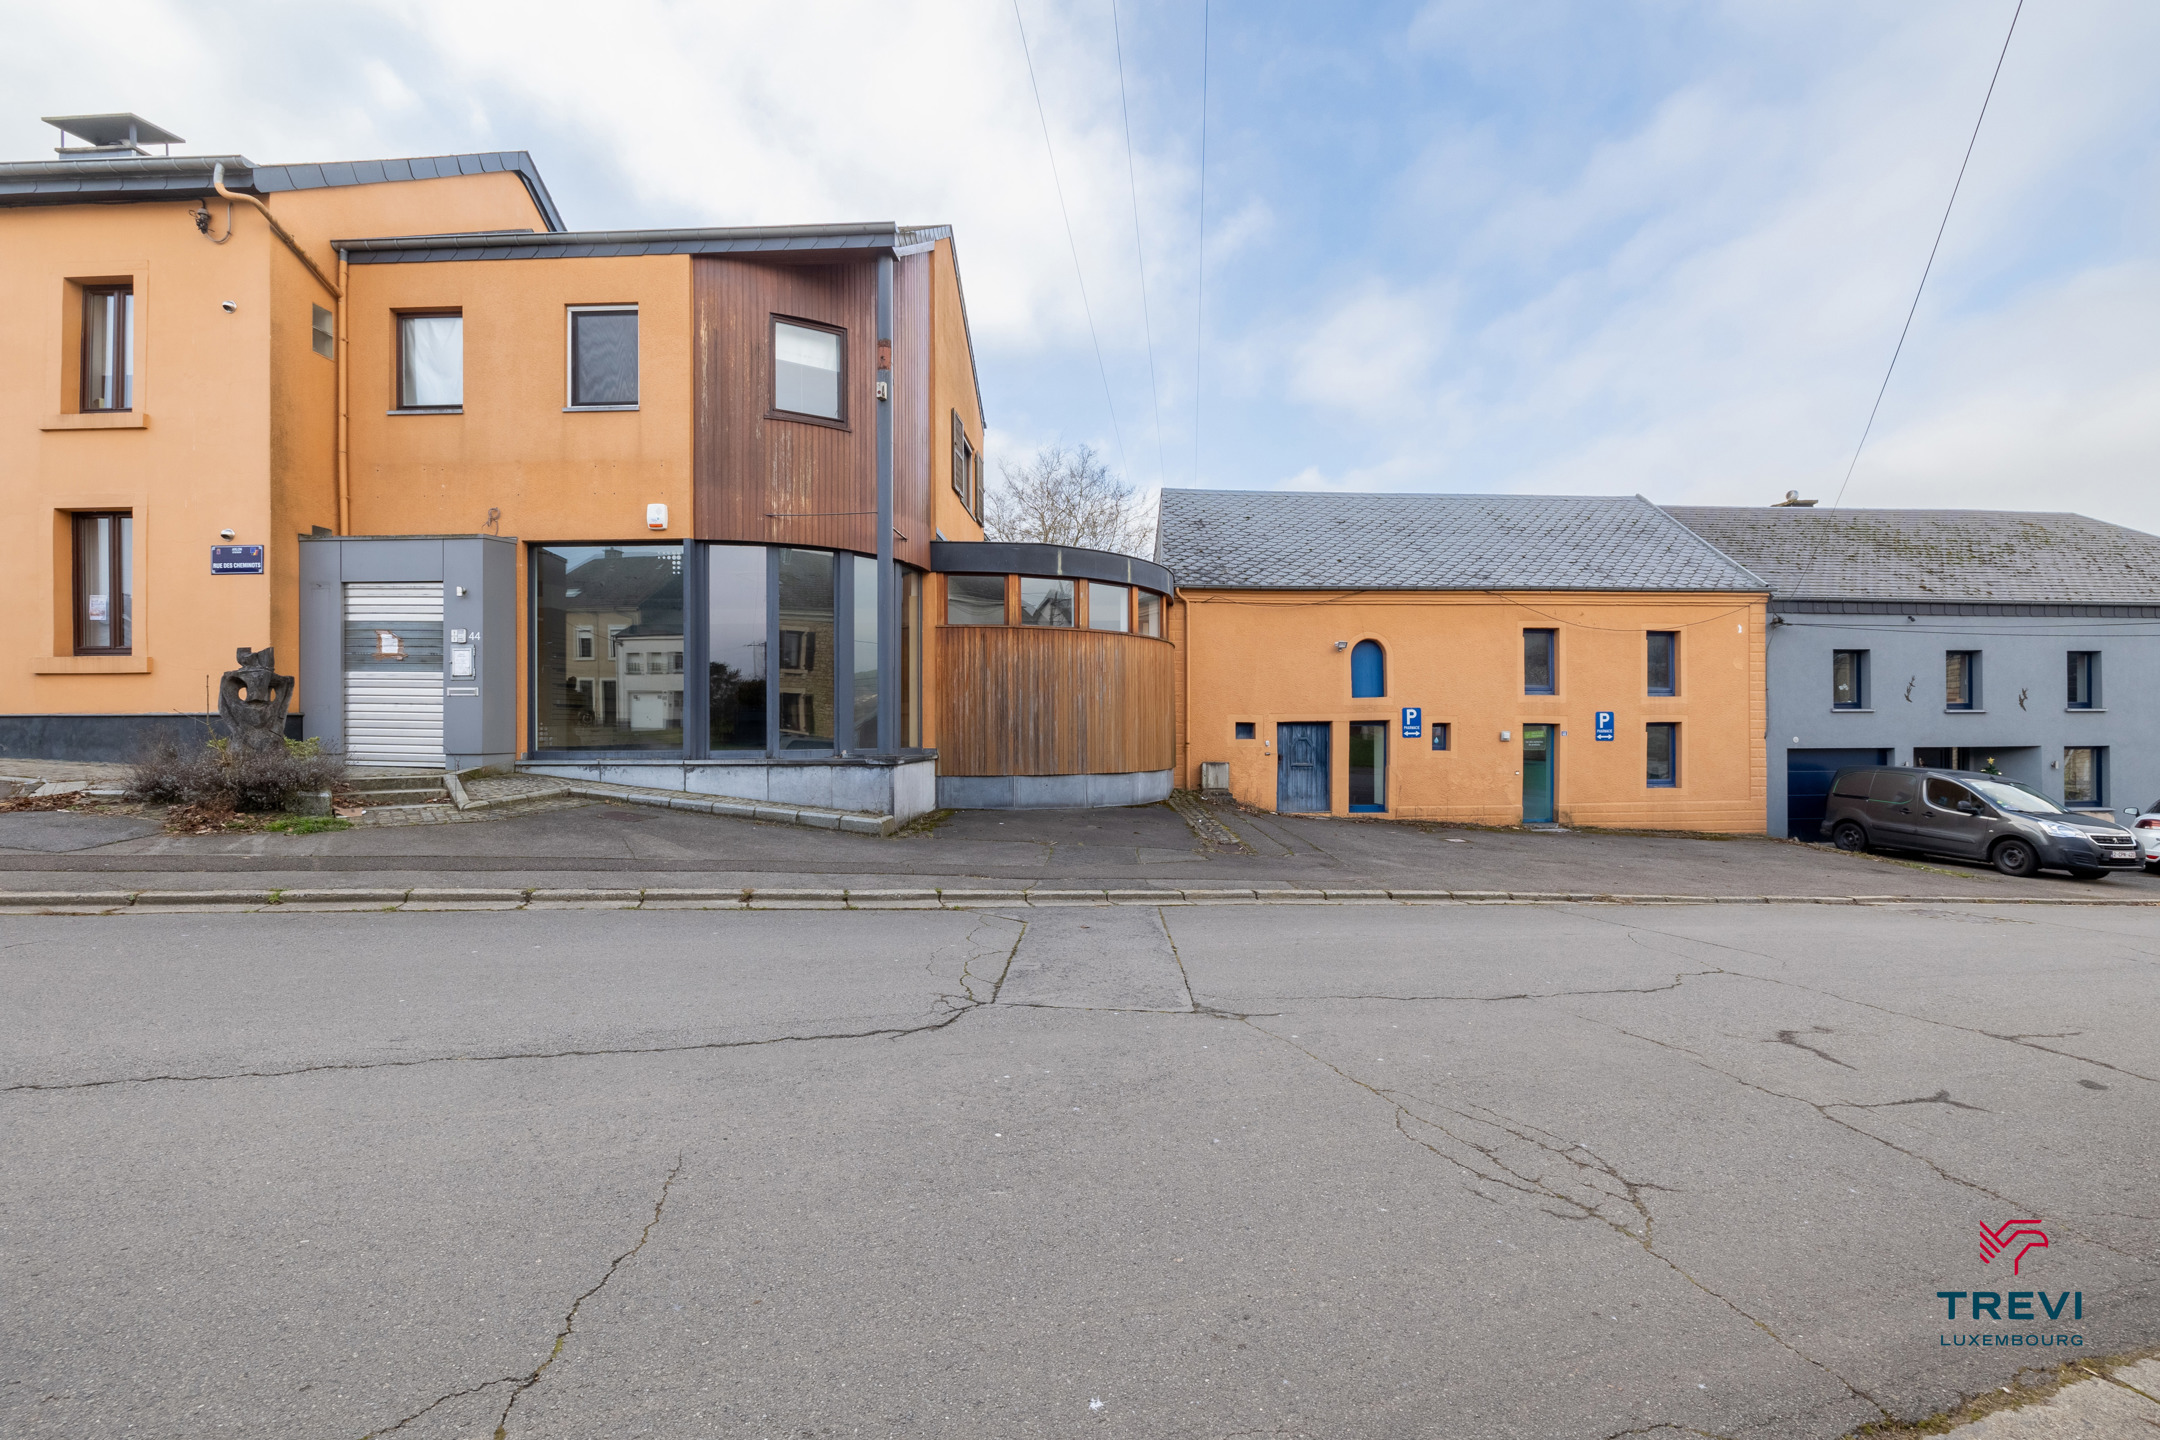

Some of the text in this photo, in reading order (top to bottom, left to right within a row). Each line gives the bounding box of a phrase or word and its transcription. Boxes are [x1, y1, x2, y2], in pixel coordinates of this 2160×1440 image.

[468, 631, 480, 641] 44
[1406, 709, 1417, 725] P
[1599, 713, 1610, 728] P
